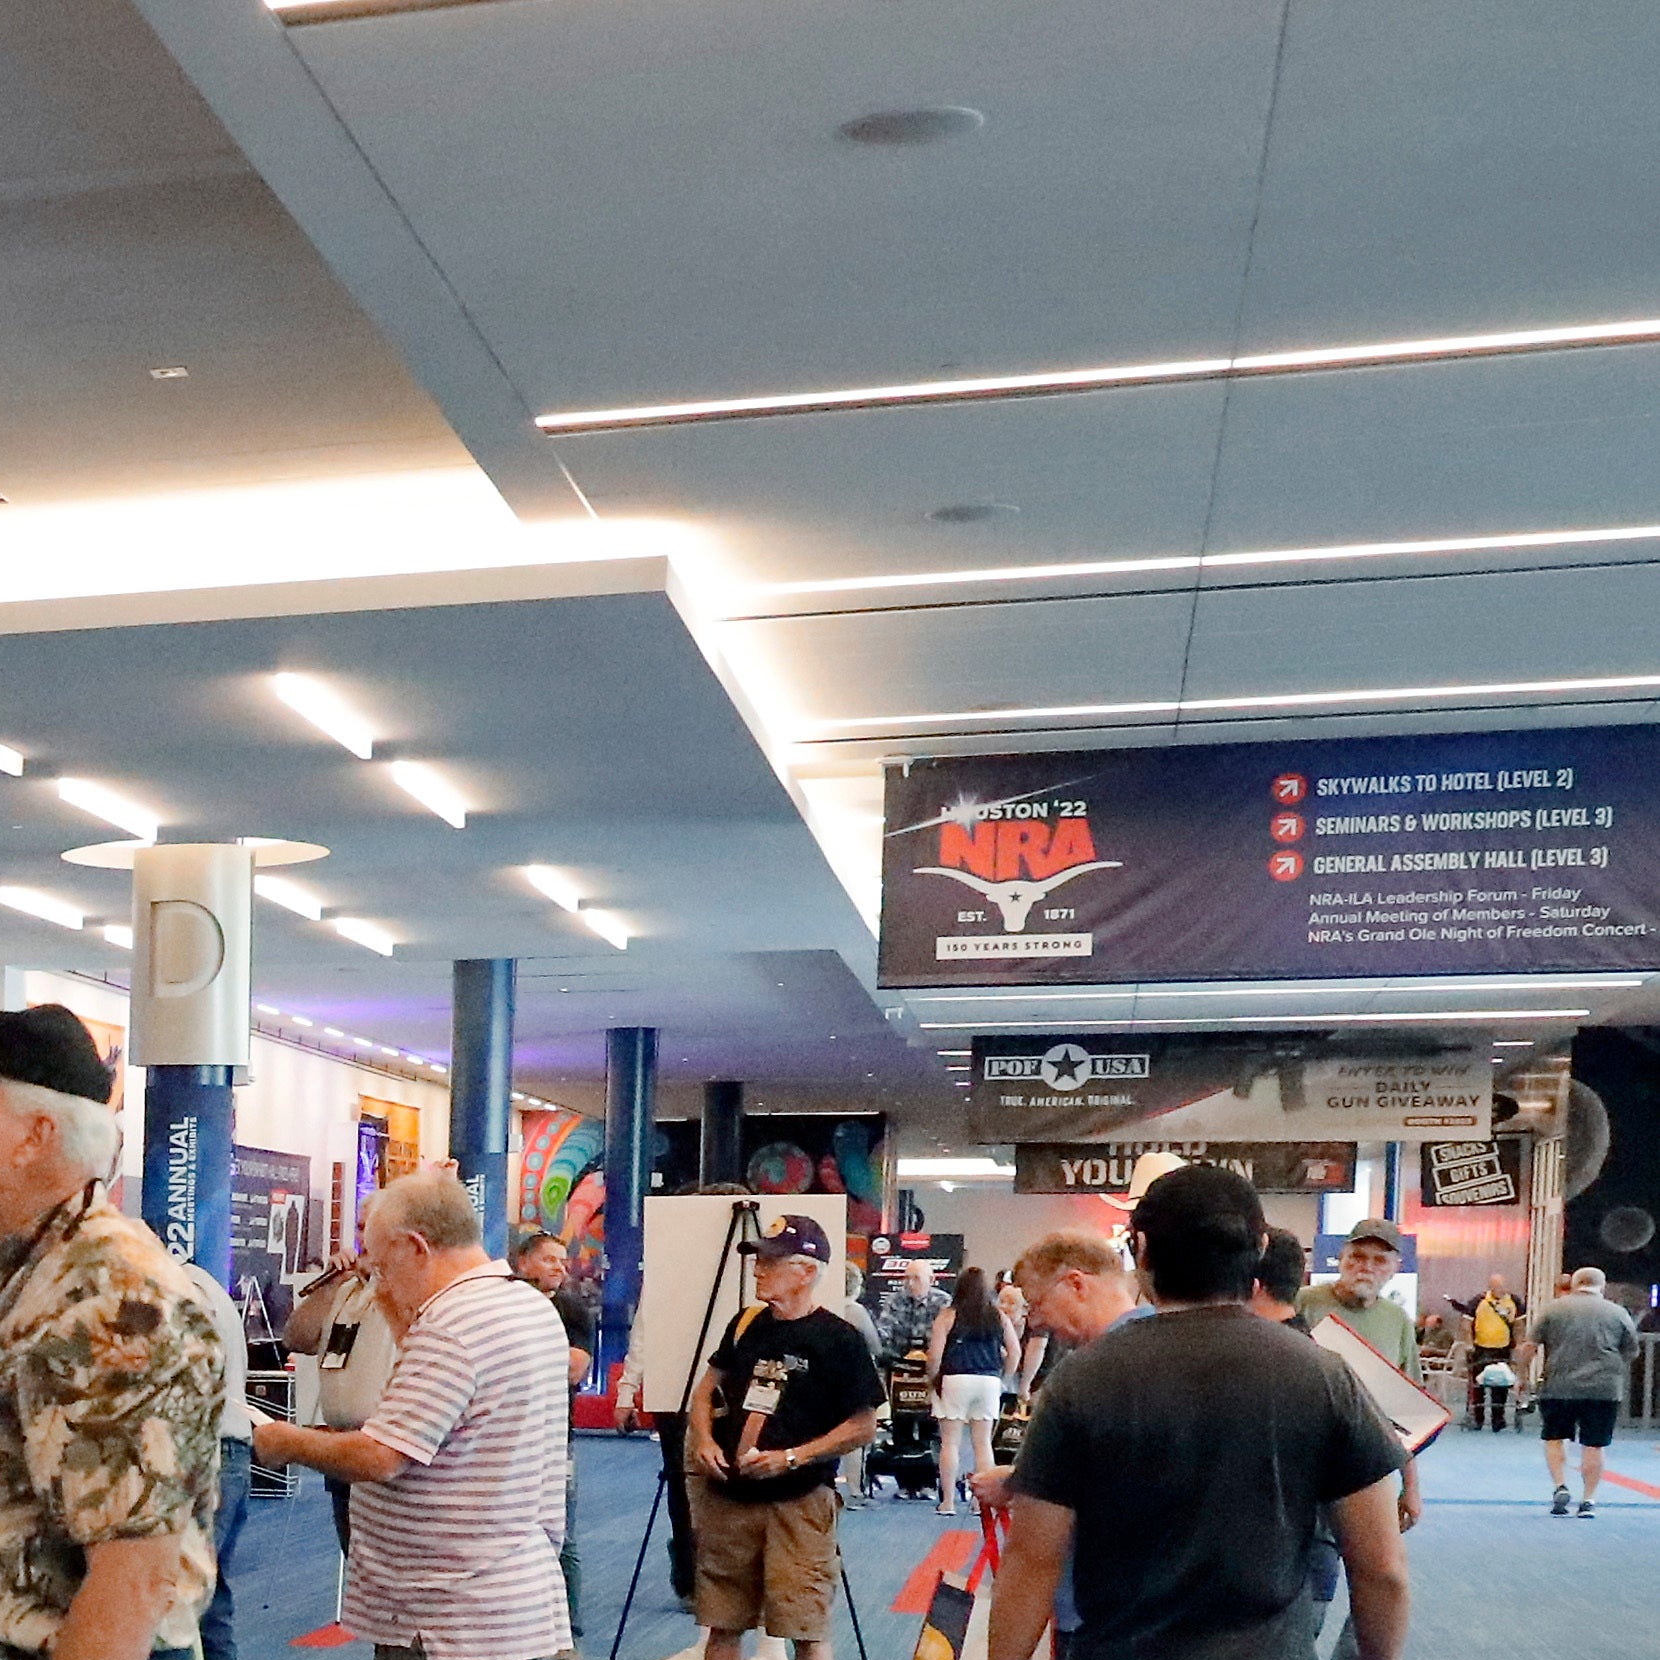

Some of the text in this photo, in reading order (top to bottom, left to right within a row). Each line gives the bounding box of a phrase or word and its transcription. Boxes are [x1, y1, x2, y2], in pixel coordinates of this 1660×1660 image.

[1316, 775, 1412, 797] SKYWALKS
[1416, 774, 1437, 793] TO
[1440, 771, 1494, 792] HOTEL
[1555, 767, 1574, 790] 2)
[941, 800, 1088, 821] USTON '22
[1315, 814, 1401, 836] SEMINARS
[1421, 810, 1533, 832] WORKSHOPS
[1593, 805, 1614, 829] 3)
[938, 817, 1098, 882] NRA
[1313, 854, 1387, 875] GENERAL
[1390, 851, 1483, 872] ASSEMBLY
[1483, 849, 1527, 870] HALL
[1589, 845, 1609, 869] 3)
[1309, 891, 1374, 907] NRA-ILA
[1377, 887, 1464, 906] Leadership
[1467, 887, 1518, 902] Forum
[1531, 885, 1582, 904] Friday
[957, 908, 1076, 923] EST. 1871
[1308, 910, 1363, 926] Annual
[1365, 908, 1429, 928] Meeting
[1432, 907, 1450, 922] of
[1452, 906, 1526, 922] Members
[1539, 903, 1612, 924] Saturday
[1308, 921, 1647, 944] NRA's Grand Ole Night of Freedom Concert
[148, 899, 225, 998] D
[946, 940, 1083, 953] 150 YEARS STRONG
[991, 1057, 1144, 1077] POF USA
[1374, 1081, 1432, 1094] DAILY
[1326, 1096, 1482, 1110] GUN GIVEAWAY
[1440, 1142, 1488, 1162] SNACKS
[167, 1116, 190, 1221] ANNUAL
[1061, 1158, 1133, 1186] YOU
[1449, 1163, 1488, 1184] GIFTS
[186, 1172, 197, 1222] MEETINGS
